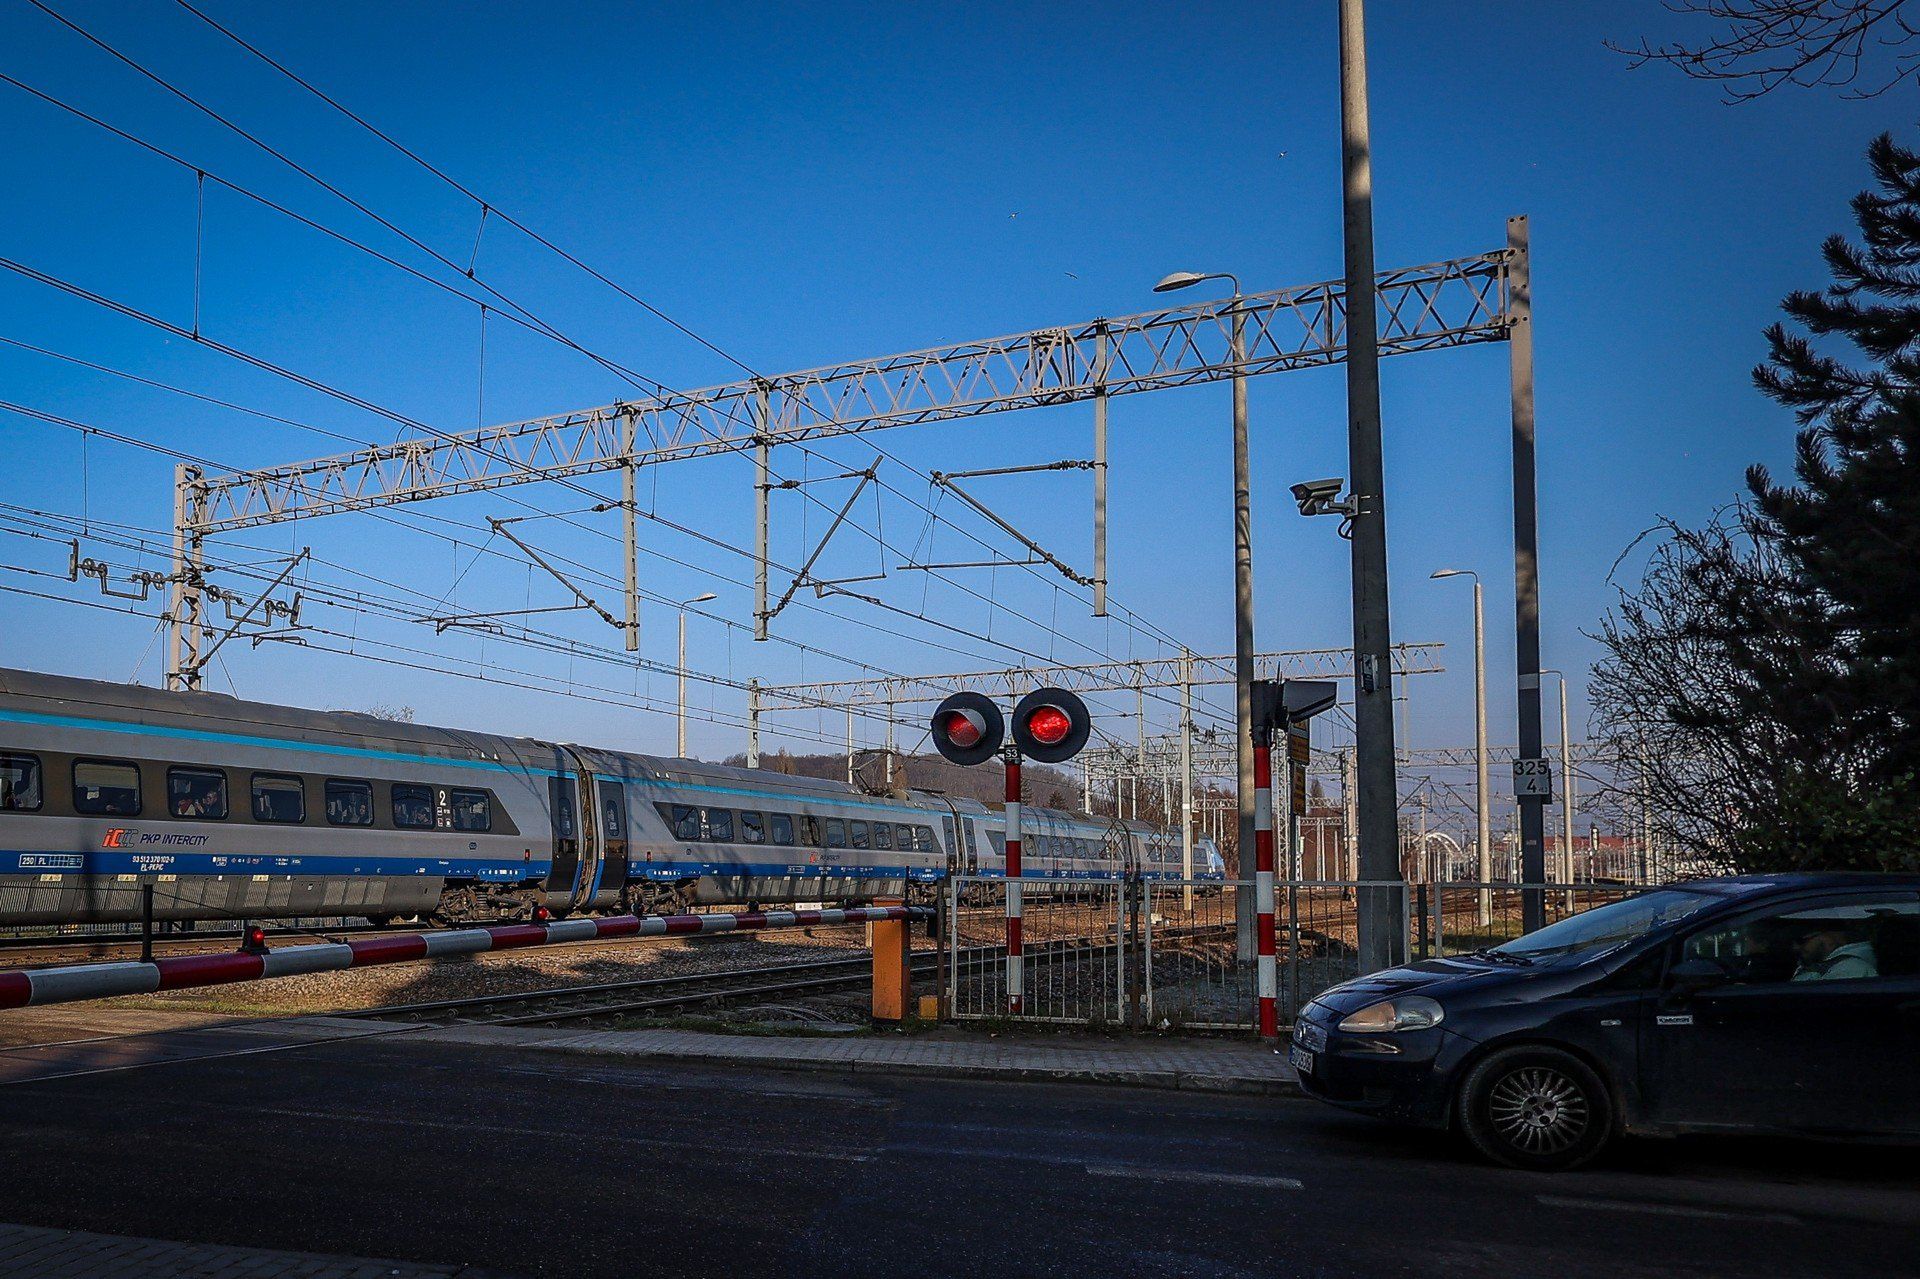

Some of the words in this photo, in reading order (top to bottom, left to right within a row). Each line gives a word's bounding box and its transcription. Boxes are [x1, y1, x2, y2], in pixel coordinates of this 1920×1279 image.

[1514, 761, 1548, 776] 325
[1526, 778, 1537, 794] 4
[439, 790, 447, 806] 2
[701, 810, 706, 823] 2
[140, 833, 161, 844] PKP
[161, 834, 210, 846] INTERCITY
[21, 857, 34, 865] 250
[38, 857, 47, 865] PL
